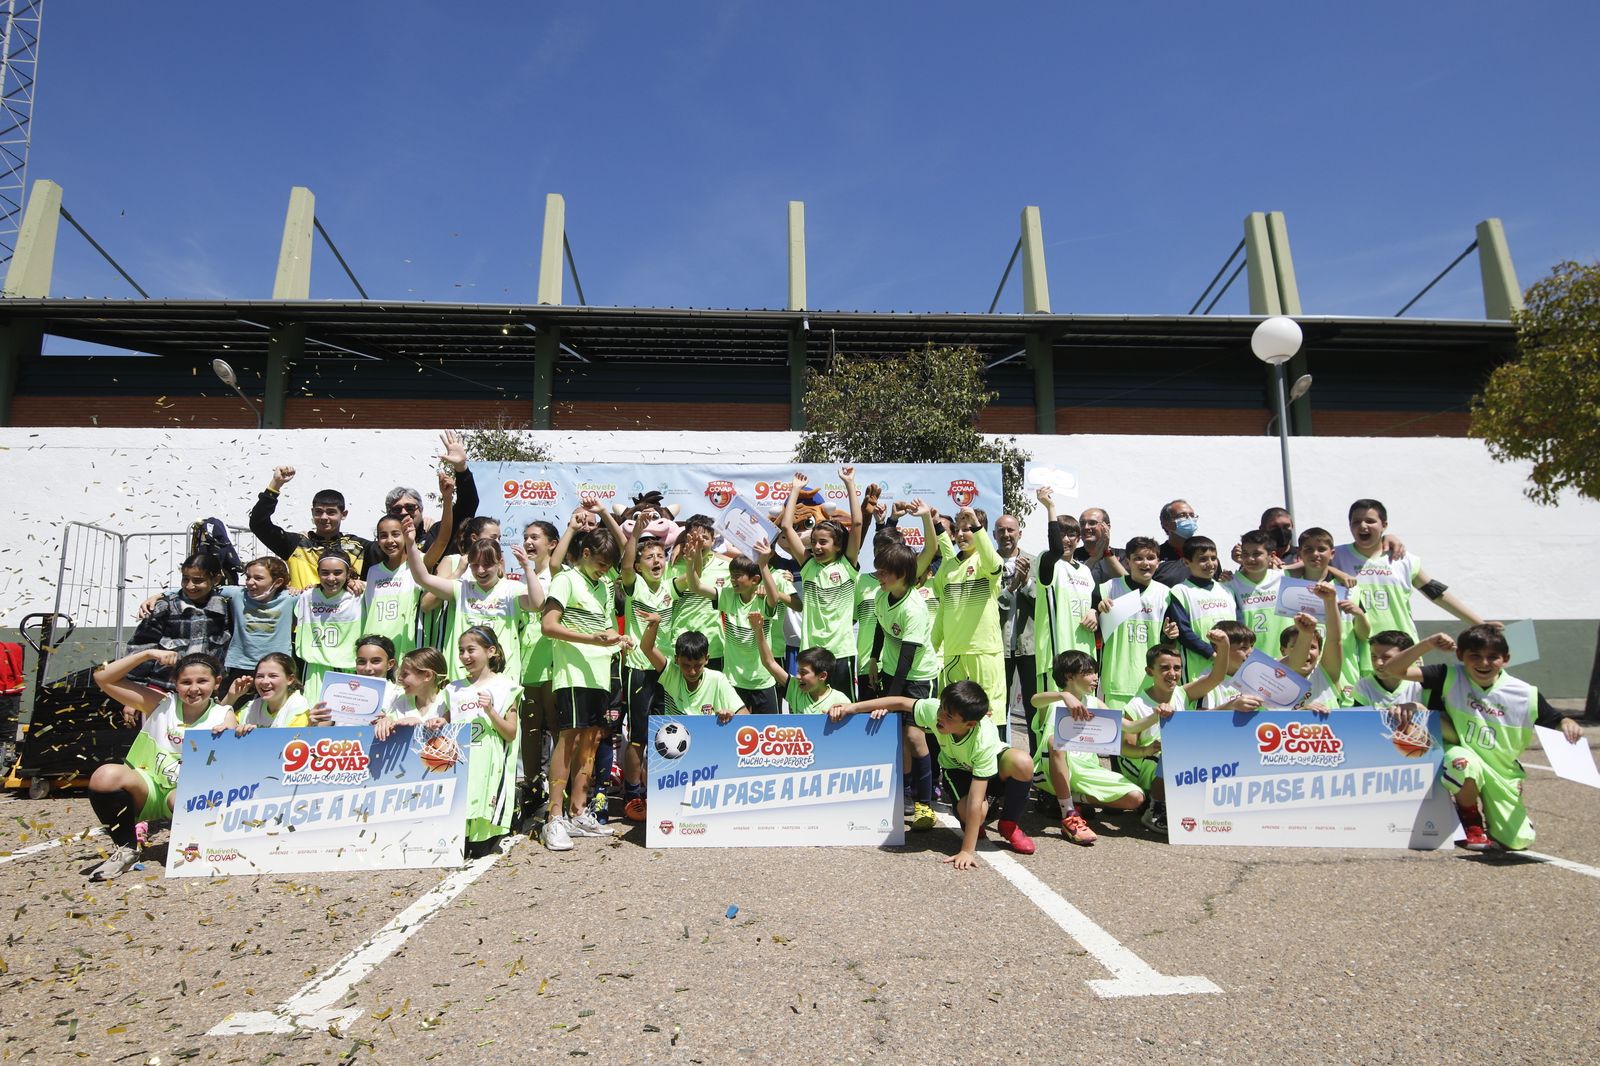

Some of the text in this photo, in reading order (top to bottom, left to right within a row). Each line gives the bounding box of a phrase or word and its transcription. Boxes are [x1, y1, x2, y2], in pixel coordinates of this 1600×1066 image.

[524, 480, 553, 491] COPA
[521, 490, 557, 500] COVAP
[580, 491, 616, 499] COVAP
[828, 491, 862, 499] COVP
[1245, 595, 1277, 605] COVAP
[1362, 589, 1389, 611] 19
[376, 600, 399, 621] 19
[1253, 613, 1268, 633] 2
[311, 627, 339, 648] 20
[1127, 623, 1148, 643] 16
[764, 726, 806, 742] COPA
[1287, 723, 1334, 740] COPA
[1465, 721, 1497, 750] 10
[316, 740, 362, 756] COPA
[760, 742, 812, 756] COVAP
[1284, 739, 1342, 754] COVAP
[155, 752, 182, 784] 14
[310, 756, 369, 772] COVAP
[657, 764, 719, 791] vale por
[1174, 761, 1240, 787] vale por
[691, 767, 884, 810] UN PASE A LA FINAL
[1213, 768, 1425, 808] UN PASE A LA FINAL
[186, 782, 260, 813] vale por
[222, 784, 446, 833] UN PASE A LA FINAL
[1205, 825, 1232, 833] COVAP
[207, 853, 237, 862] COVAP
